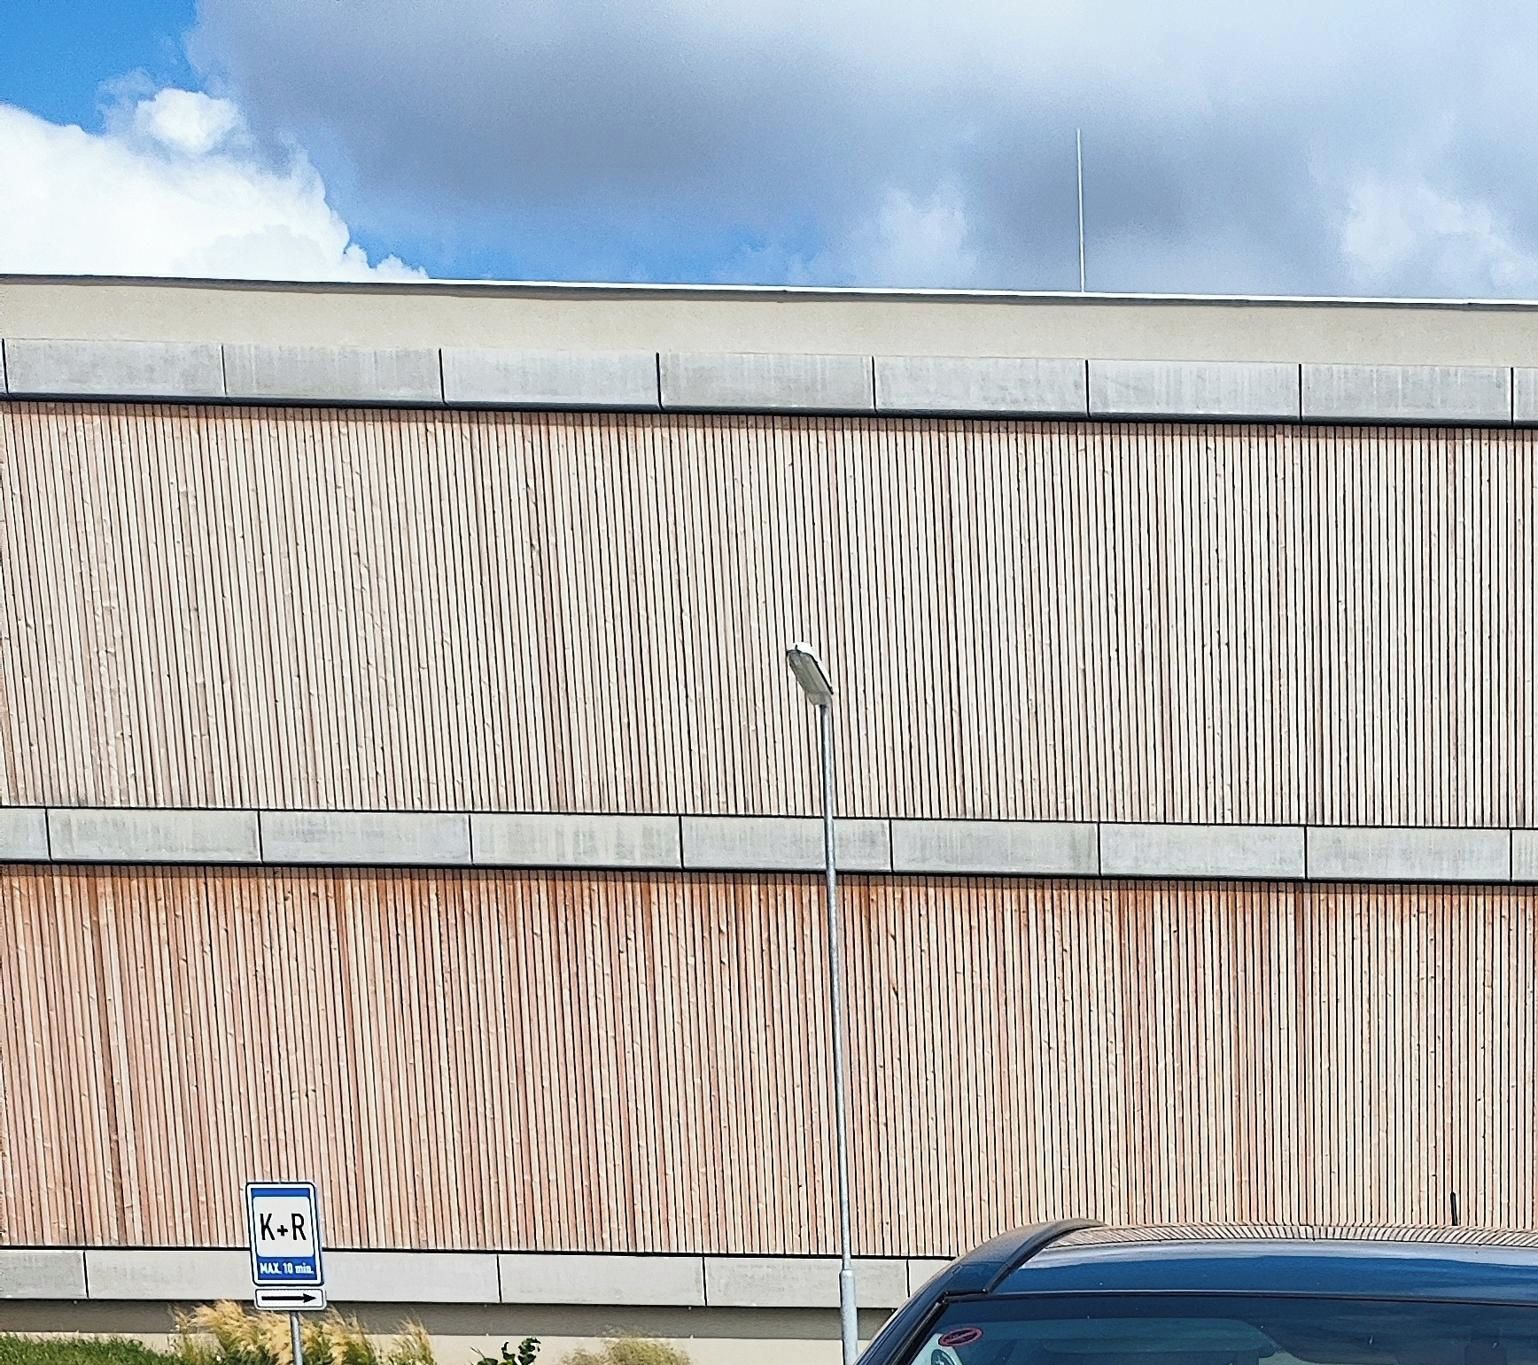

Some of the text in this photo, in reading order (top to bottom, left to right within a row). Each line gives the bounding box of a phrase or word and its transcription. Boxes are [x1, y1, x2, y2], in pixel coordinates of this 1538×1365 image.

[259, 1212, 307, 1241] K+R
[260, 1262, 315, 1274] MAX. 10 min.
